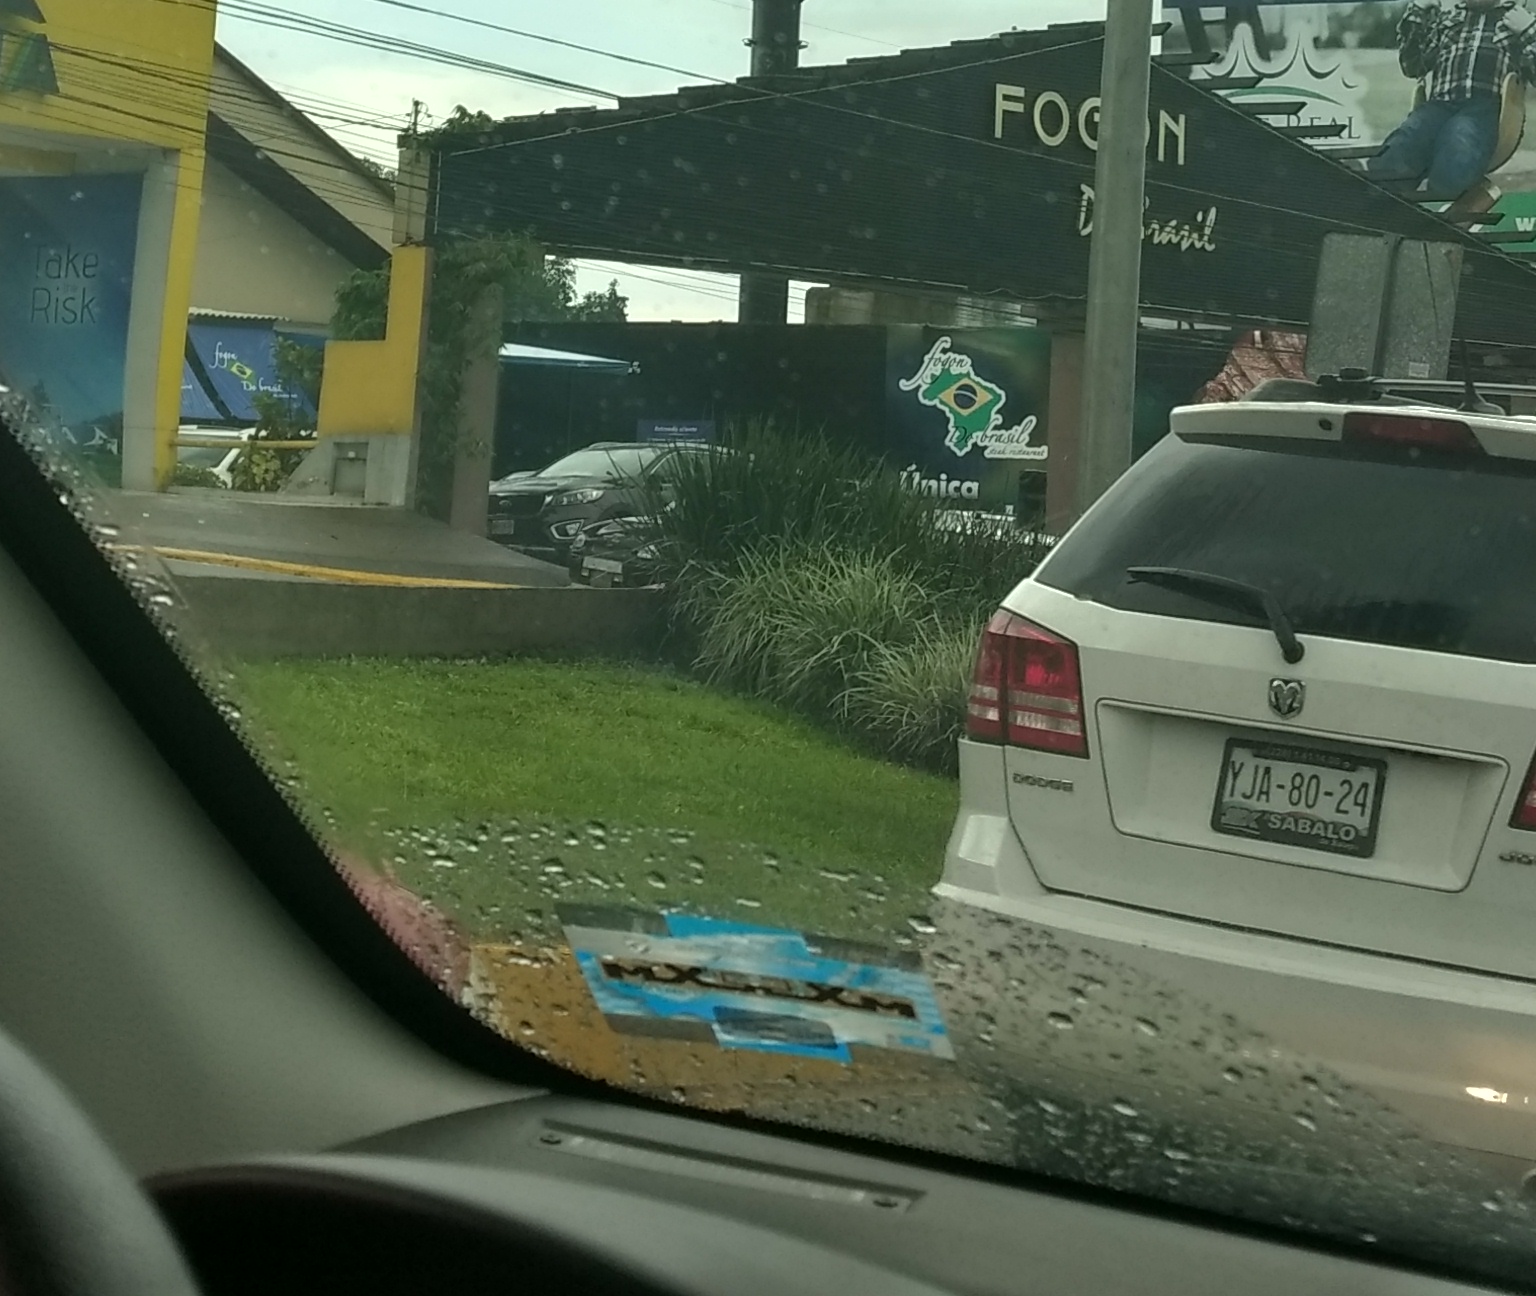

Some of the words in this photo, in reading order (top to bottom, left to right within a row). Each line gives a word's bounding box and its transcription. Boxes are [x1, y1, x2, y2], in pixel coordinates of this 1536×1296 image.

[994, 83, 1186, 166] FOGN
[32, 244, 98, 279] Take
[30, 287, 96, 324] Risk
[900, 337, 968, 390] fogon
[241, 380, 257, 391] Do
[949, 425, 974, 444] Do
[980, 415, 1036, 445] brasil
[900, 464, 979, 500] Única
[1013, 772, 1074, 792] DODGE
[1229, 760, 1370, 818] YJA-80-24
[1268, 813, 1356, 842] SABALO
